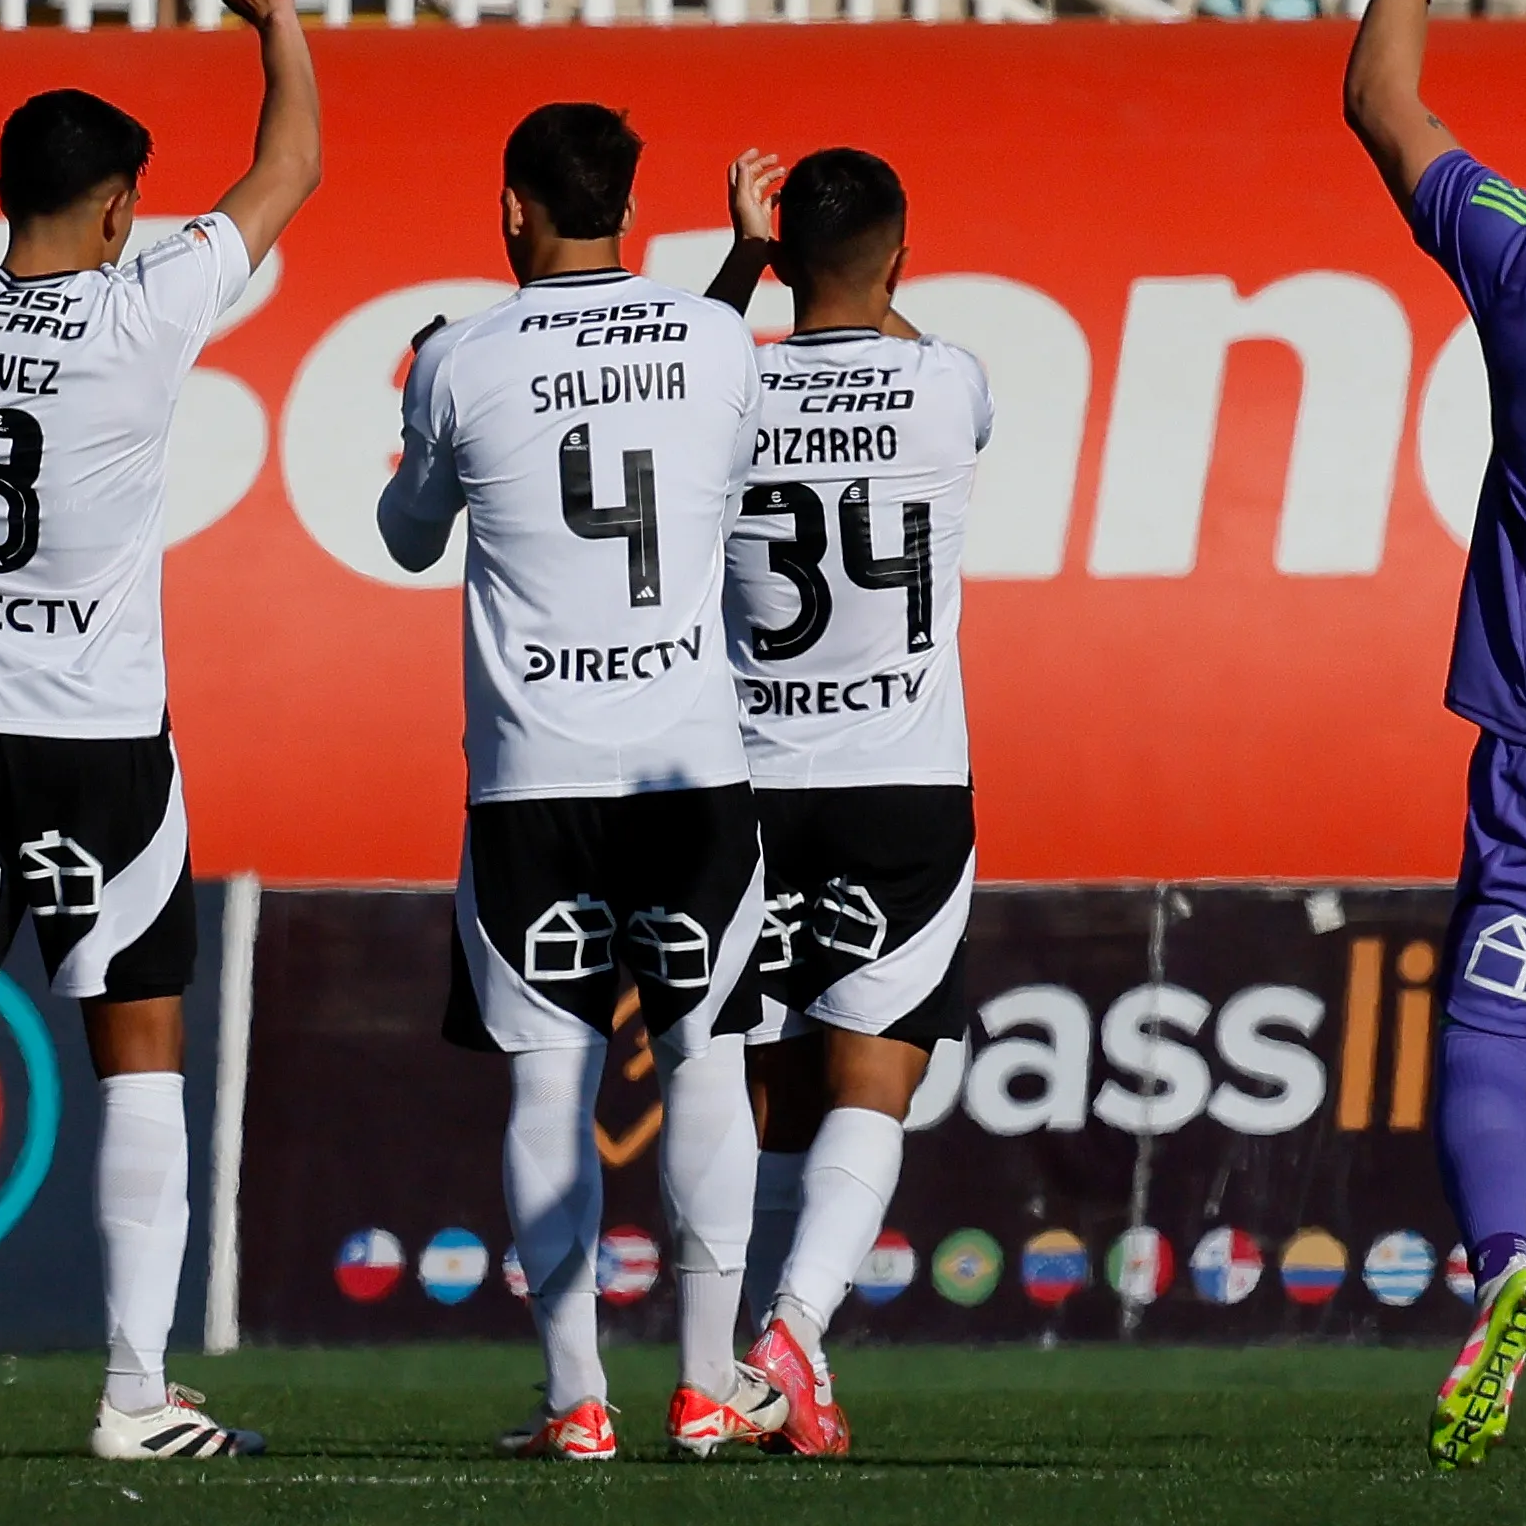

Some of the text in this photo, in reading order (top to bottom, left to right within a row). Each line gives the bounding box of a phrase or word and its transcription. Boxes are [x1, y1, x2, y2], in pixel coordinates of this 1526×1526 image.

[518, 301, 676, 334] ASSIST
[575, 322, 690, 347] CARD
[529, 361, 687, 414] SALDIVIA
[759, 367, 903, 392] ASSIST
[799, 388, 915, 414] CARD
[751, 423, 898, 467] PIZARRO
[557, 421, 663, 609] 4
[738, 477, 936, 662] 34
[522, 625, 703, 685] DIRECTV
[742, 668, 929, 717] DIRECTV
